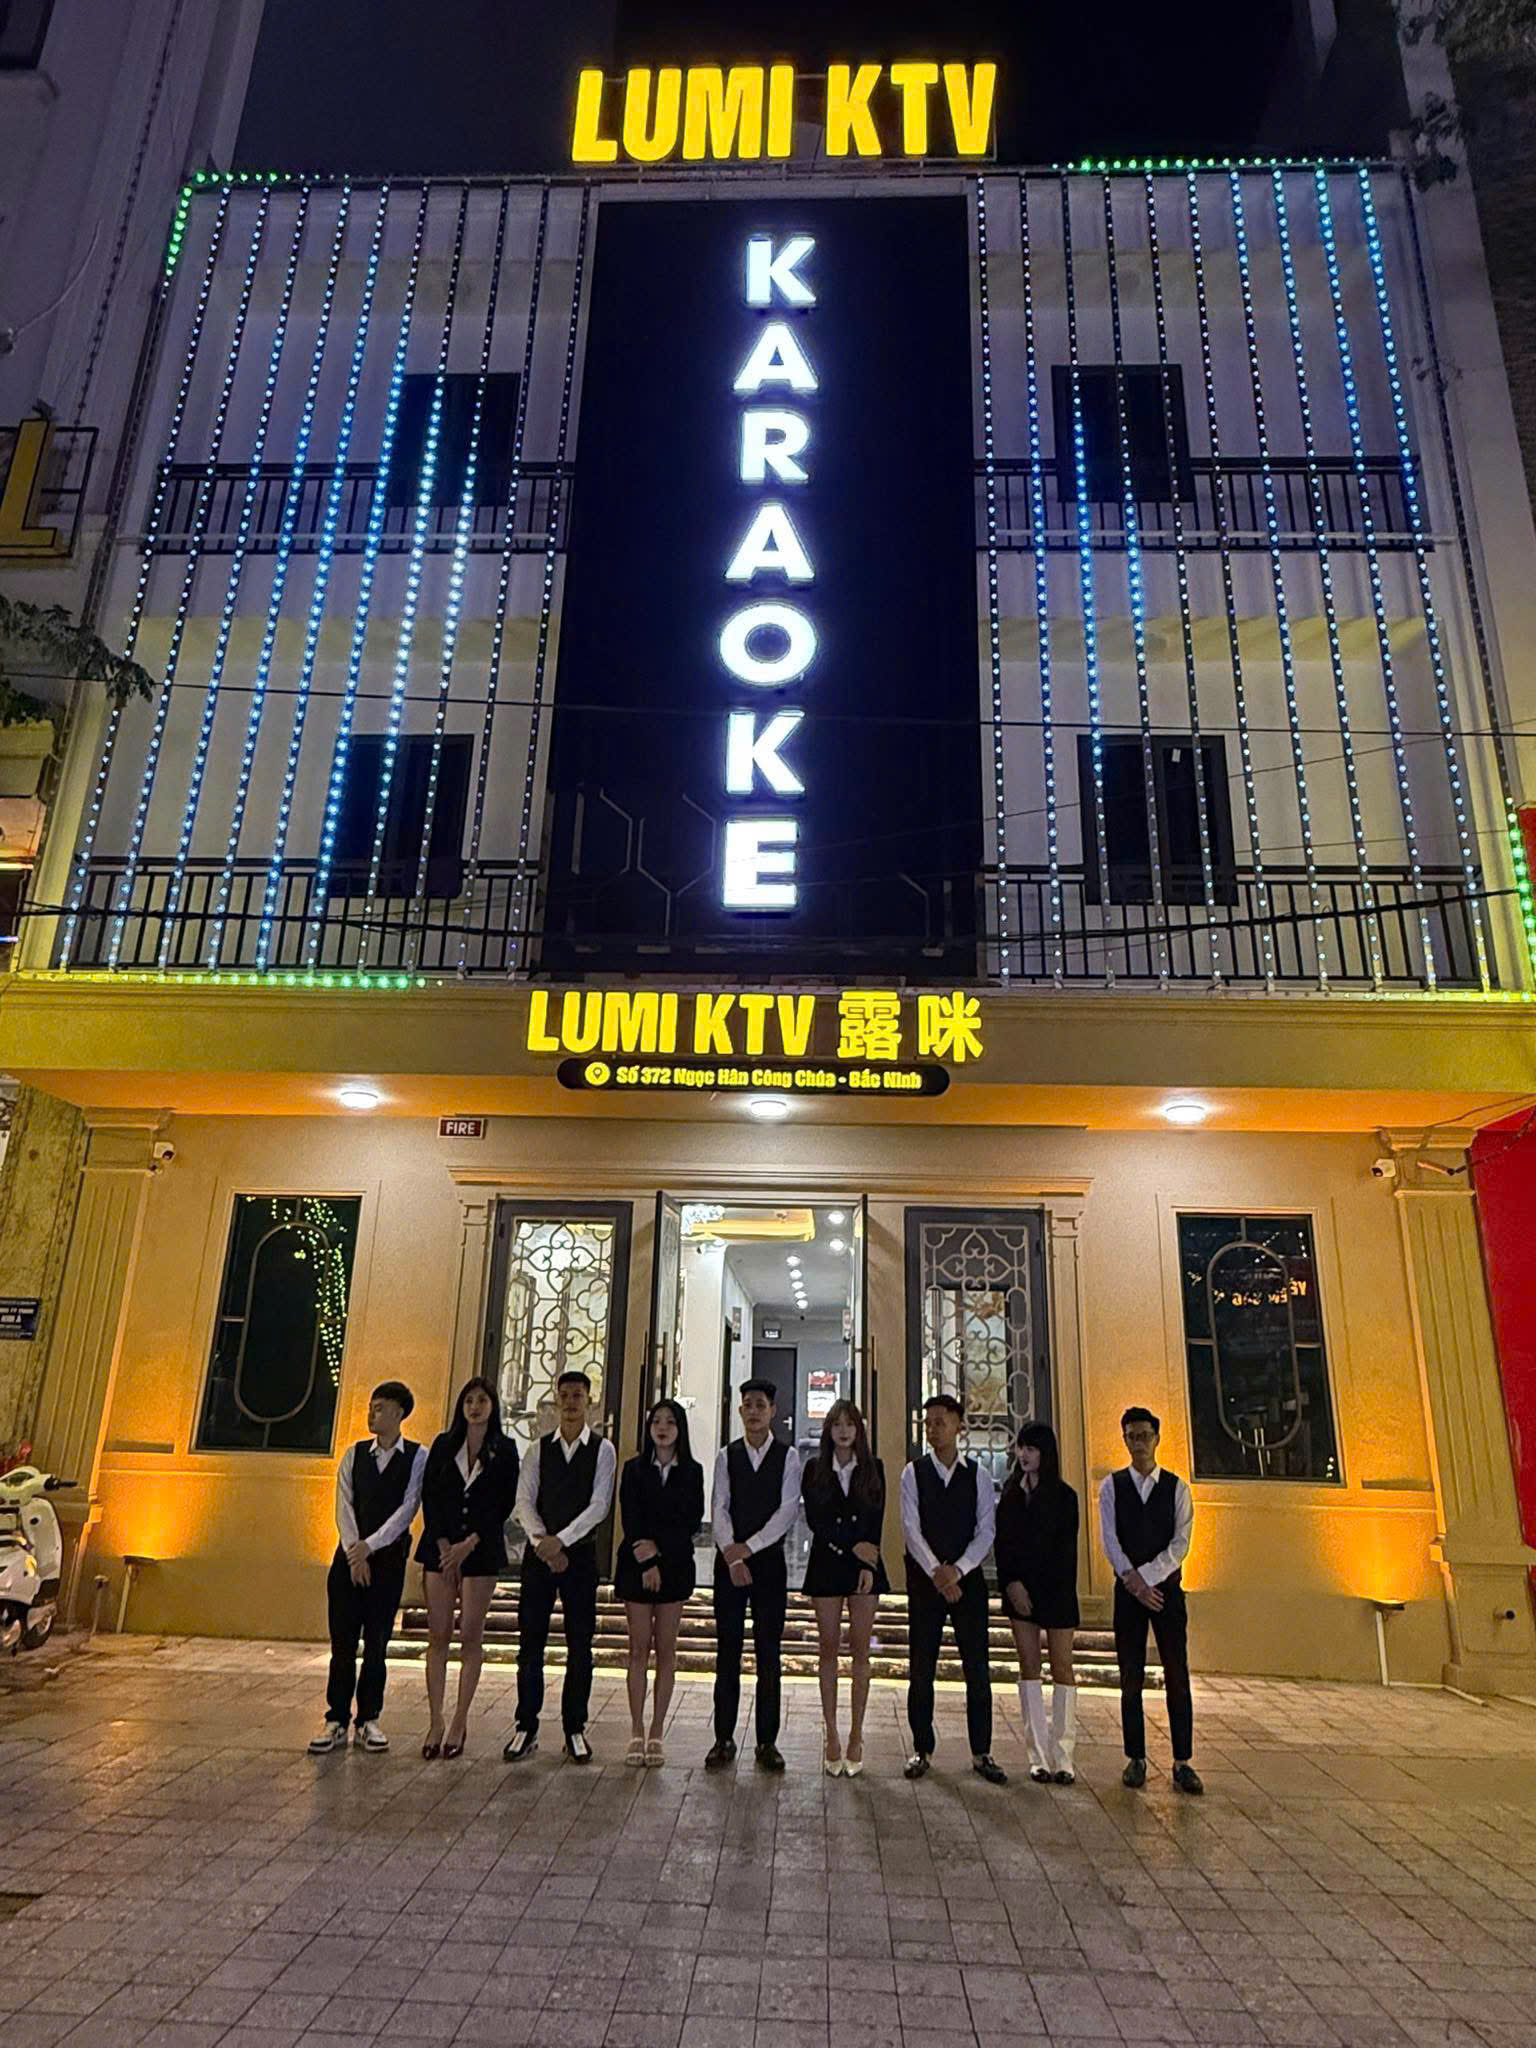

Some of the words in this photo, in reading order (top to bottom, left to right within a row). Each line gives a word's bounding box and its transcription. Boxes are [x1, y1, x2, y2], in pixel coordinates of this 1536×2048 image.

[572, 65, 794, 162] LUMI
[826, 63, 997, 157] KTV
[719, 236, 819, 911] KARAOKE
[526, 990, 678, 1054] LUMI
[694, 993, 816, 1057] KTV
[616, 1065, 639, 1084] Số
[641, 1066, 671, 1084] 372
[673, 1068, 715, 1088] Ngọc
[717, 1068, 749, 1086] Hân
[751, 1069, 792, 1088] Công
[795, 1069, 836, 1088] Chúa
[883, 1071, 922, 1089] Ninh
[446, 1121, 476, 1135] FIRE
